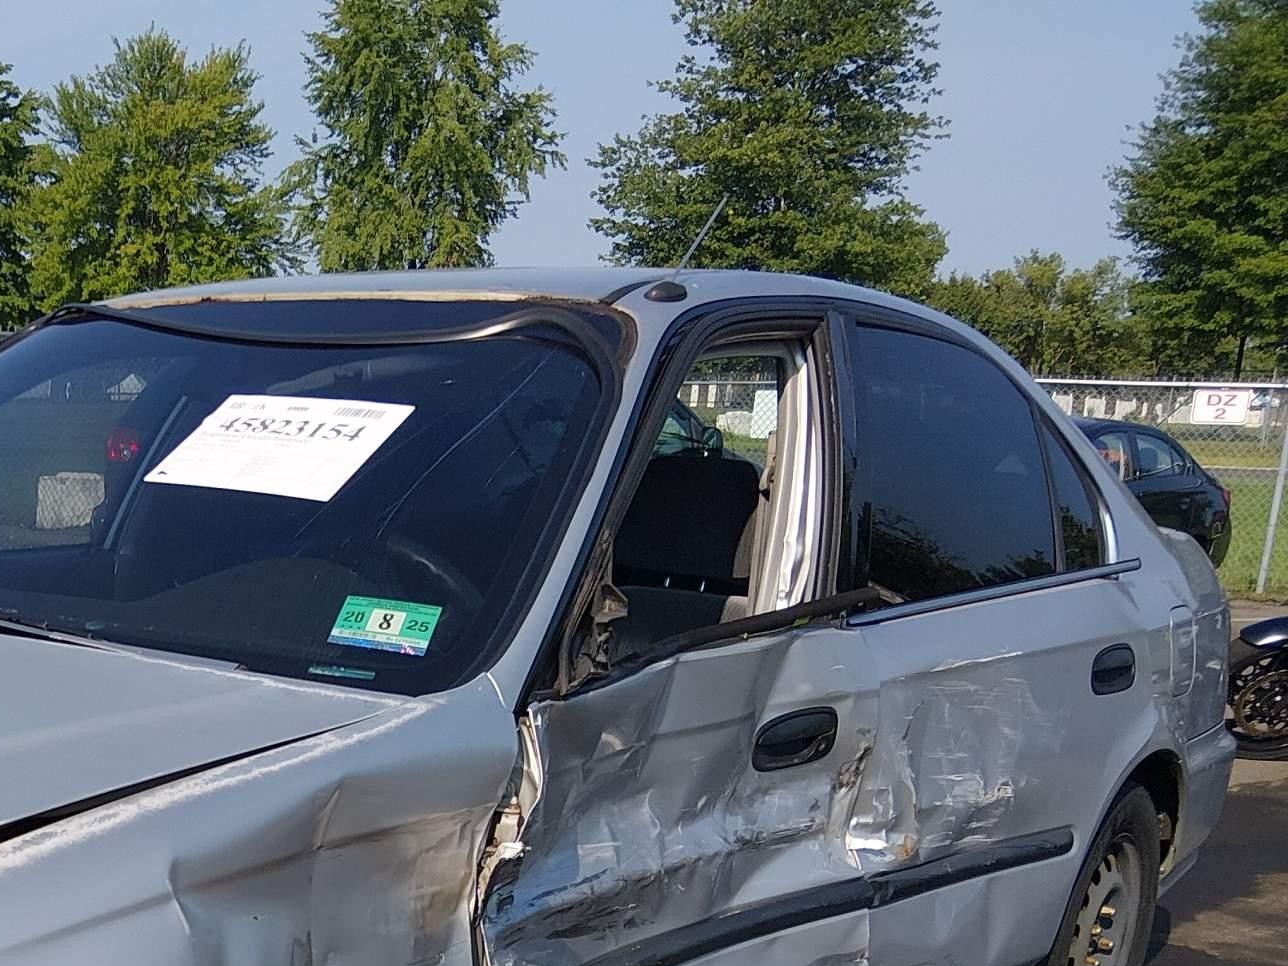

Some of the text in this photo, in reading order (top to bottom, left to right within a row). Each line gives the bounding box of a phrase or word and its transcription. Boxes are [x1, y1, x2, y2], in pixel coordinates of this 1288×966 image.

[1207, 393, 1238, 407] DZ
[1213, 407, 1227, 420] 2
[219, 416, 367, 442] 45823154
[343, 610, 432, 633] 20 8 25
